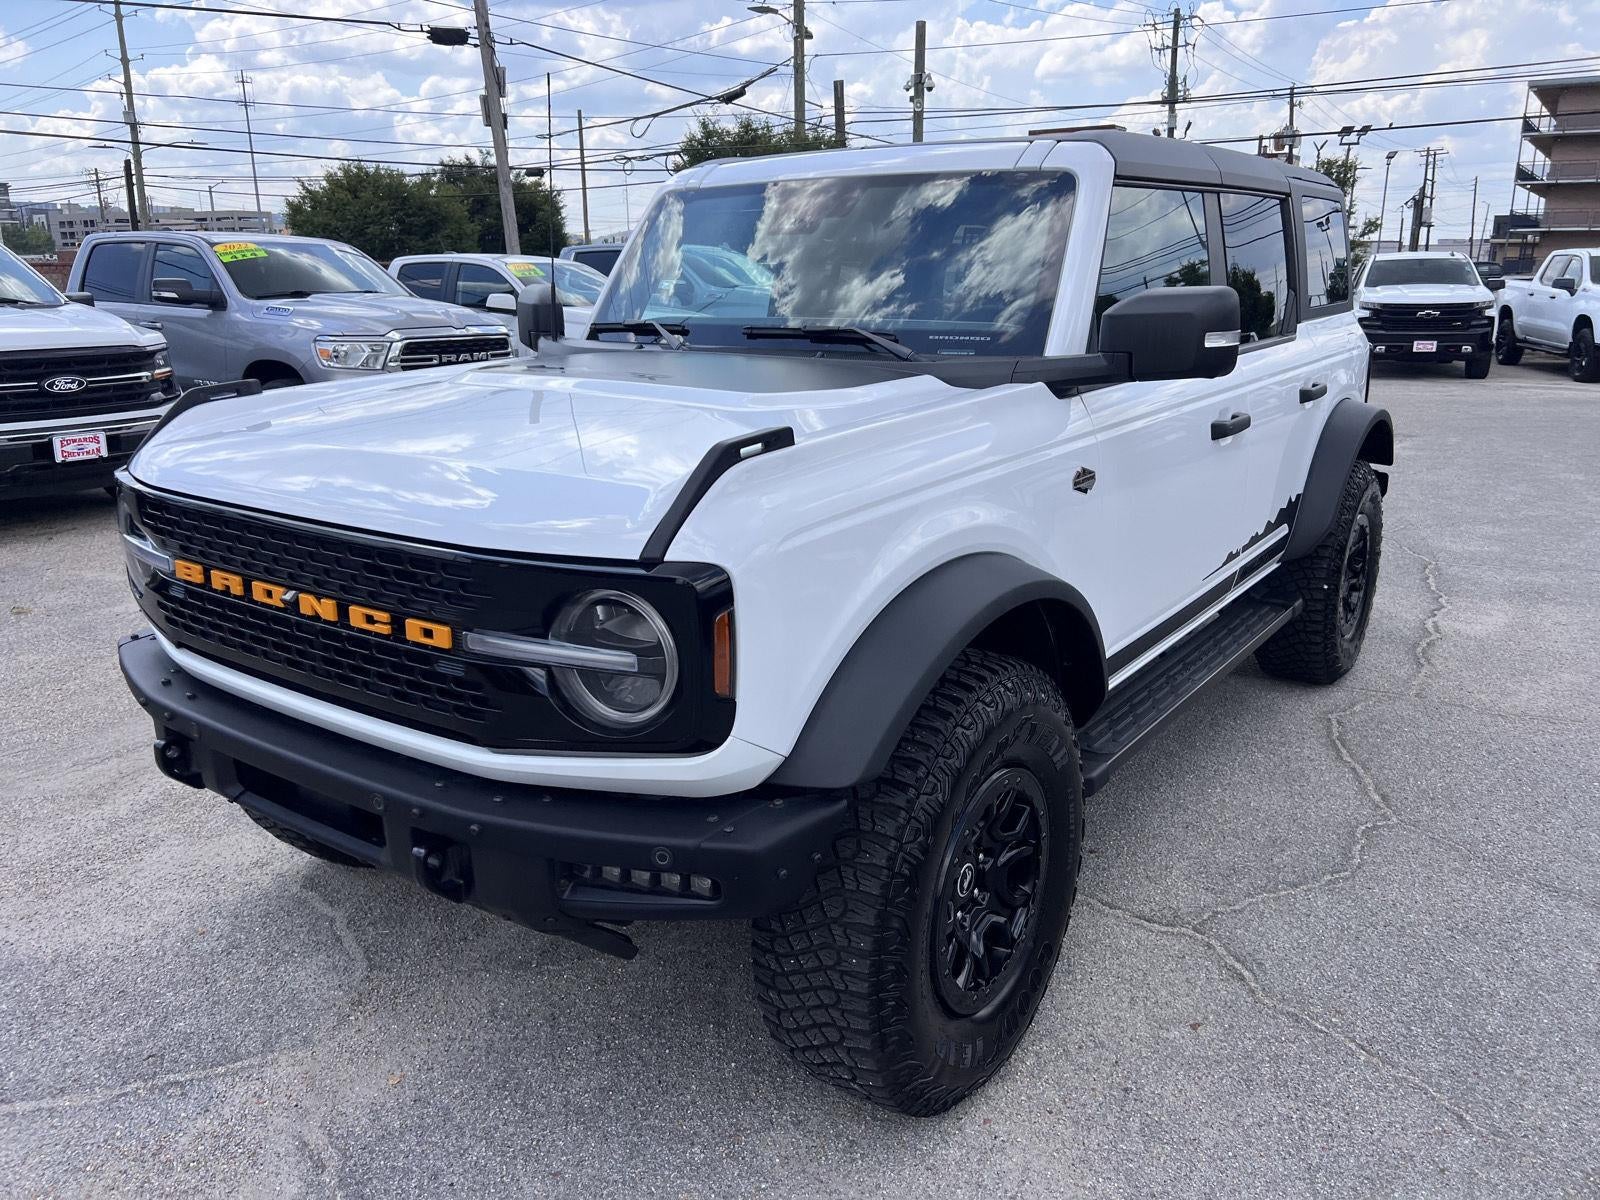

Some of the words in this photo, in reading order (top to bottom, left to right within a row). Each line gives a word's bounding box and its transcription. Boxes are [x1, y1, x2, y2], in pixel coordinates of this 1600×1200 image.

[441, 352, 487, 363] RAM
[53, 379, 79, 390] Ford
[60, 435, 101, 448] EDWARDS
[60, 446, 102, 459] CHEVYMAN
[174, 559, 453, 650] BRONCO
